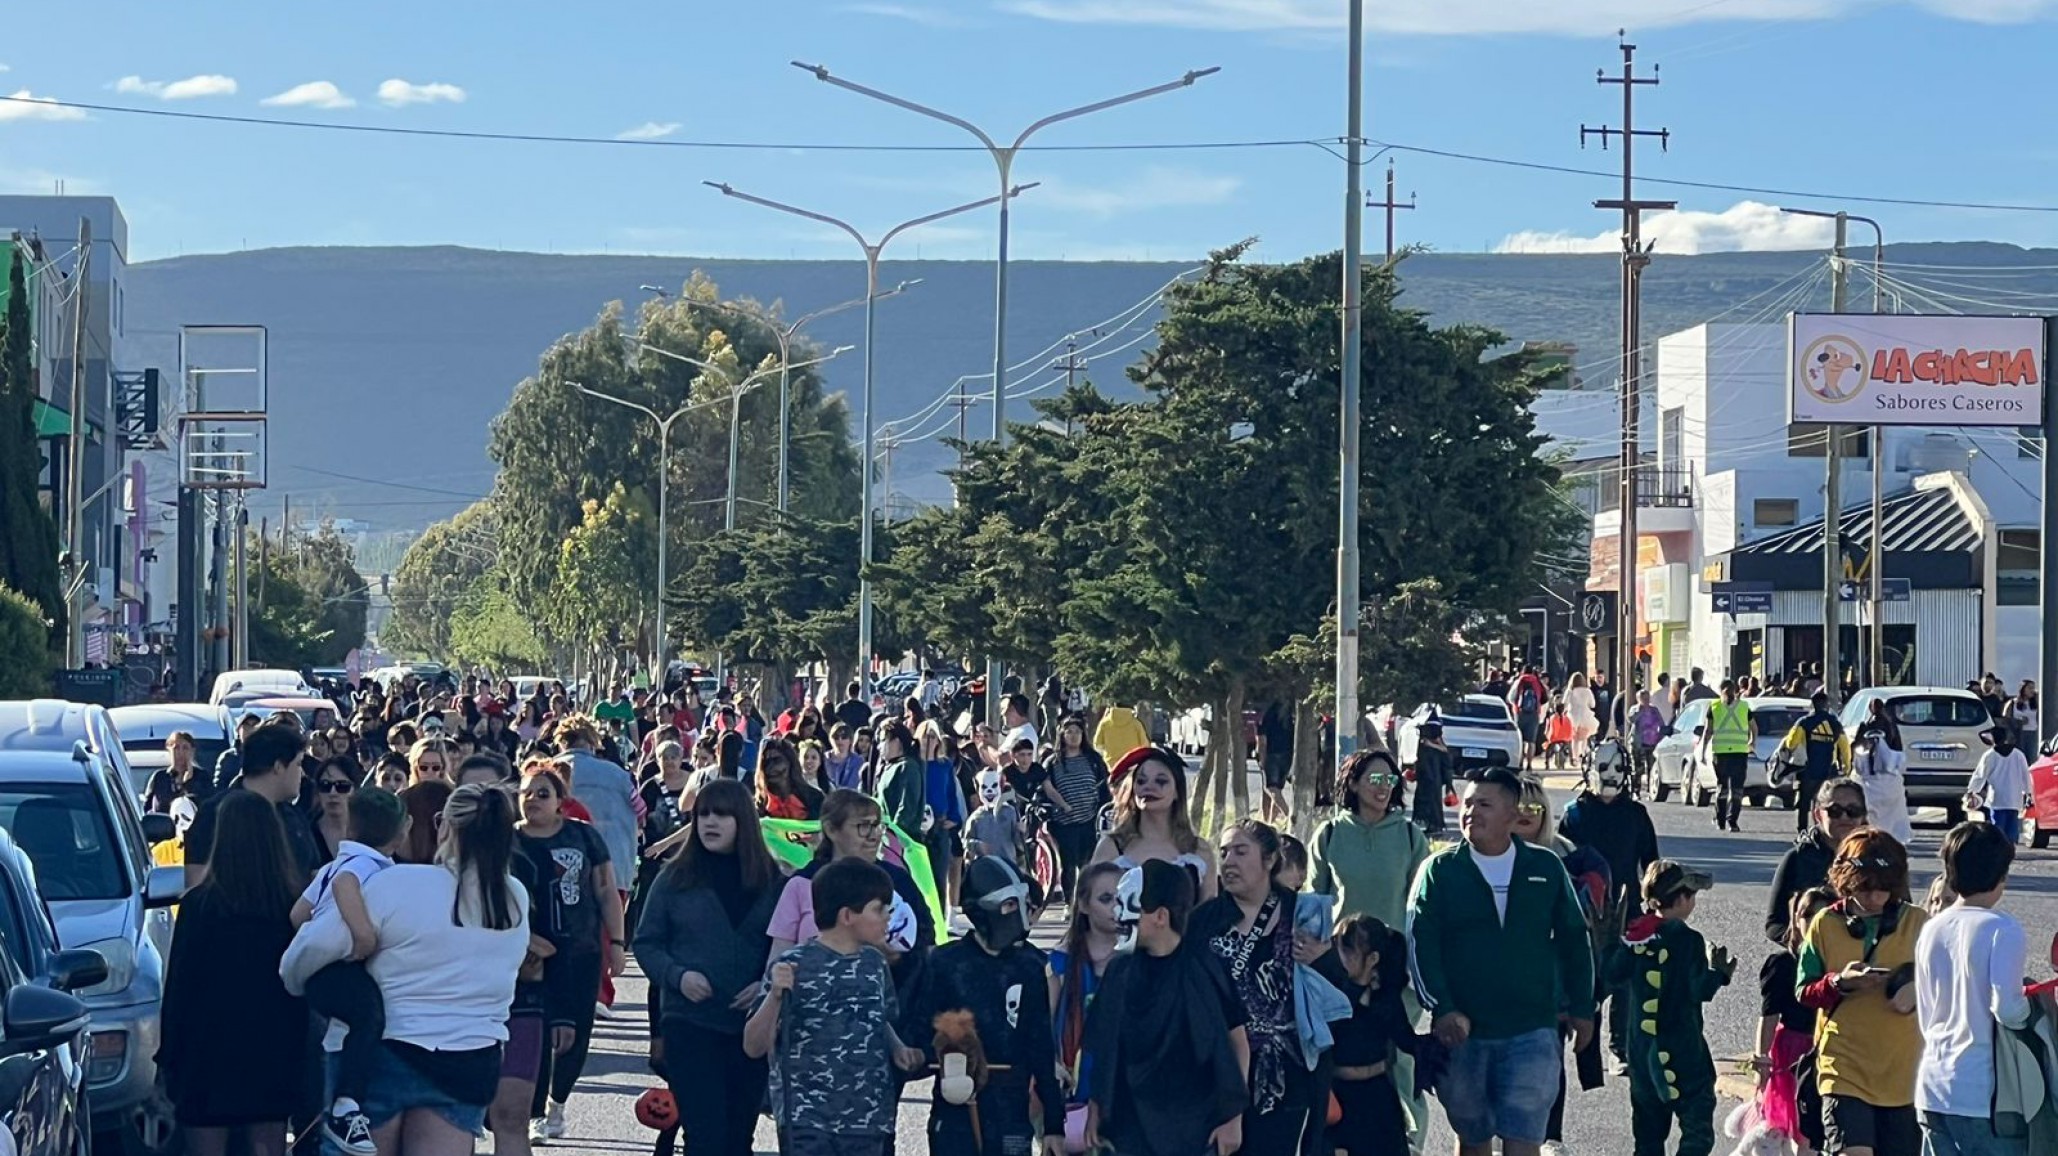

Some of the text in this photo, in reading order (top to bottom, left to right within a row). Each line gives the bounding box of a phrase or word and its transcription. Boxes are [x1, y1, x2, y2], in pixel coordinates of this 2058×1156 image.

[1875, 394, 2024, 411] Sabores Caseros
[1231, 926, 1263, 980] FASHION
